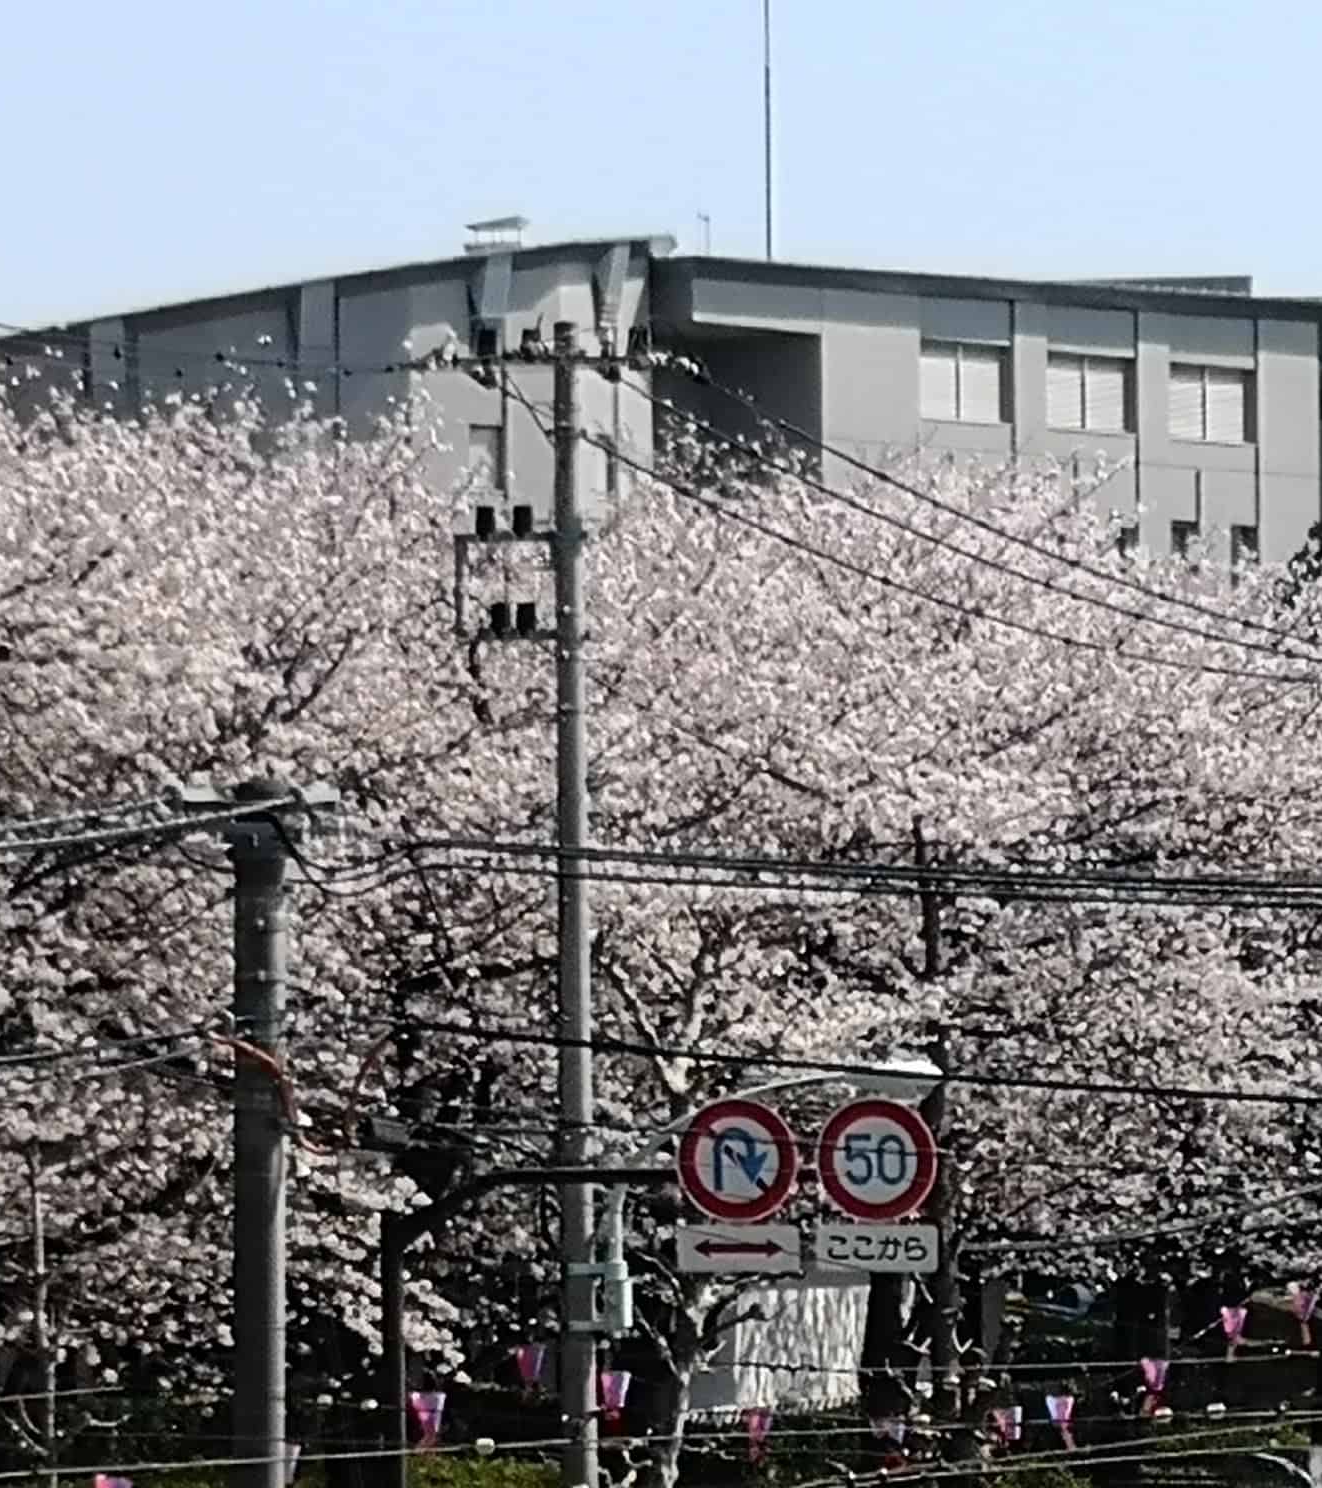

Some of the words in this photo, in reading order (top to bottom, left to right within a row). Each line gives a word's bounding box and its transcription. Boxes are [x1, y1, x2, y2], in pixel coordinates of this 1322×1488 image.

[844, 1133, 907, 1187] 50
[827, 1235, 928, 1260] ここから
